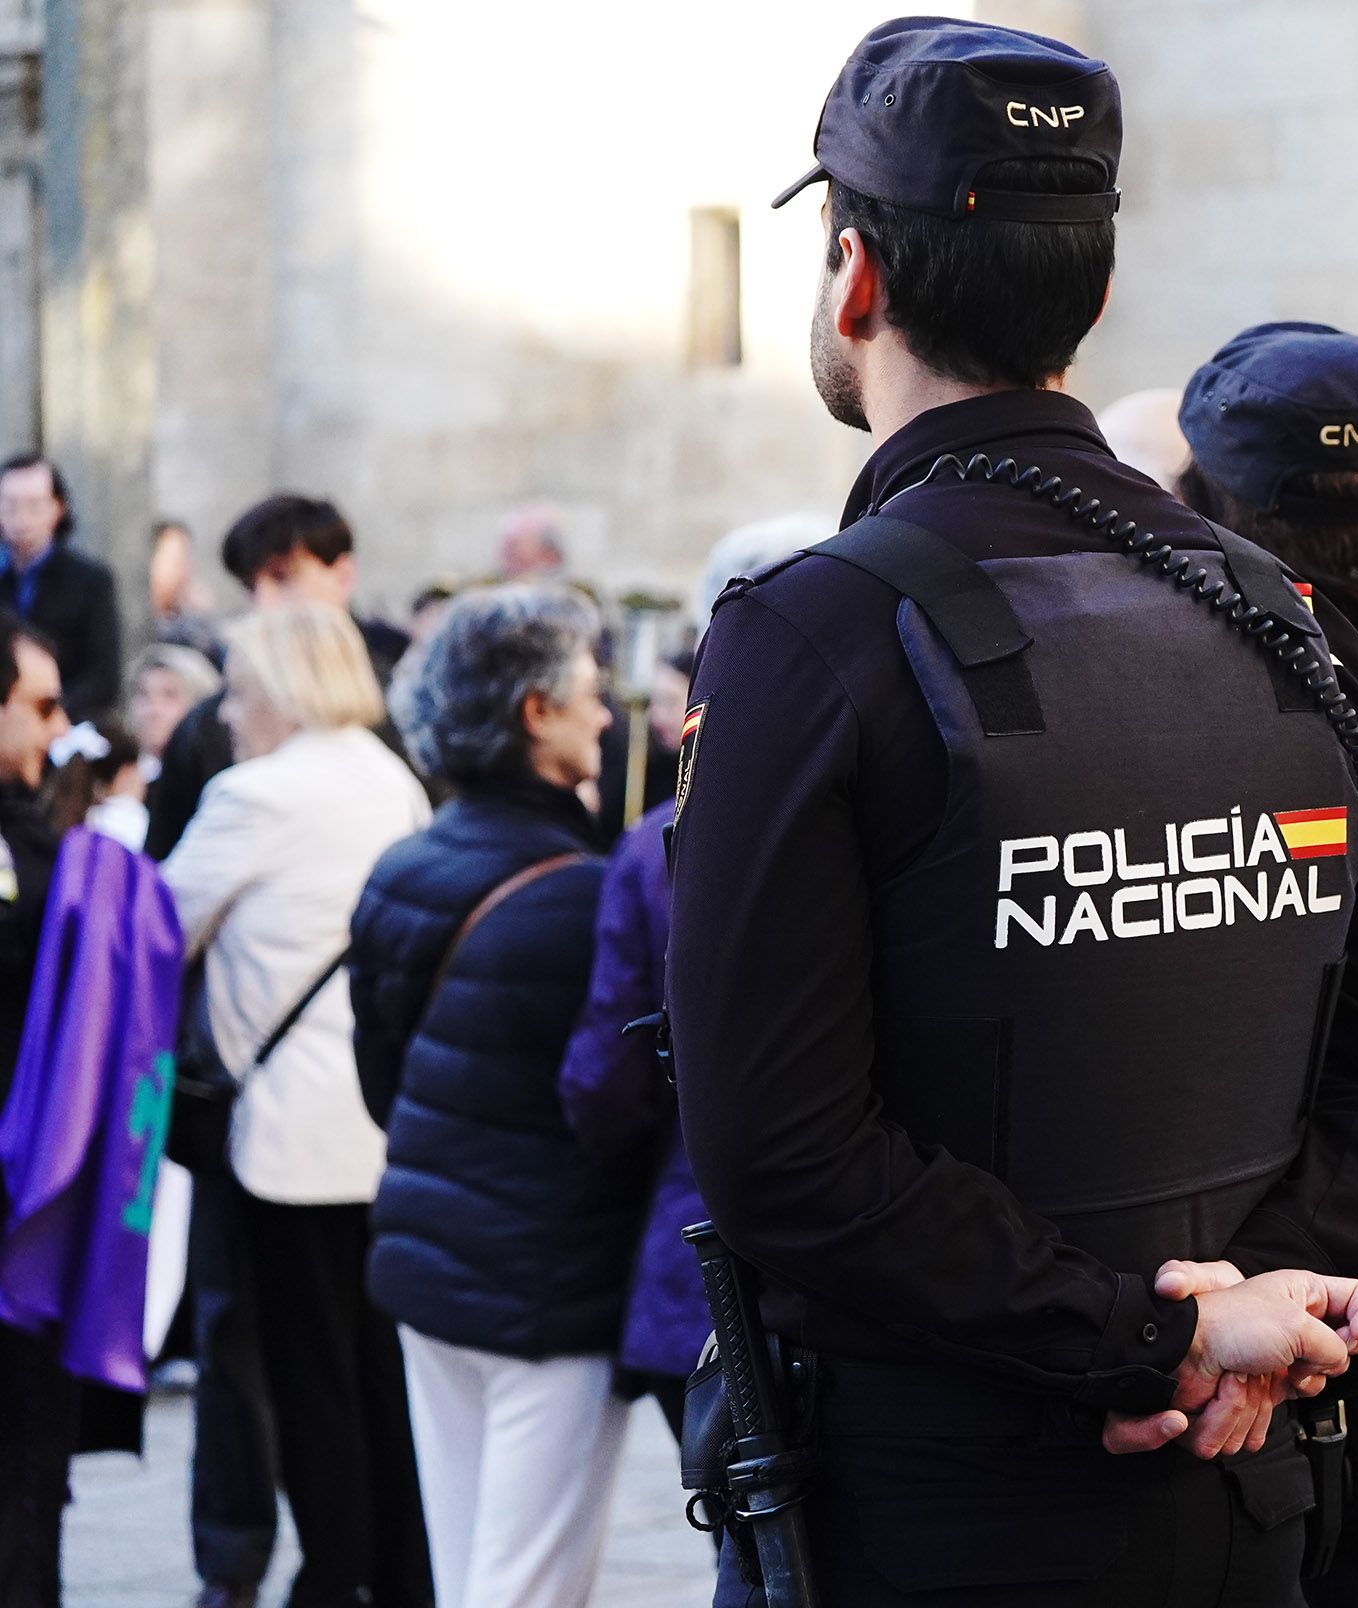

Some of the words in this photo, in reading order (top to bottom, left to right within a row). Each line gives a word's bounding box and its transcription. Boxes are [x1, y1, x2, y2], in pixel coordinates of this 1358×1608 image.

[1006, 101, 1085, 128] CNP
[997, 804, 1288, 892] POLICÍA
[994, 865, 1342, 949] NACIONAL
